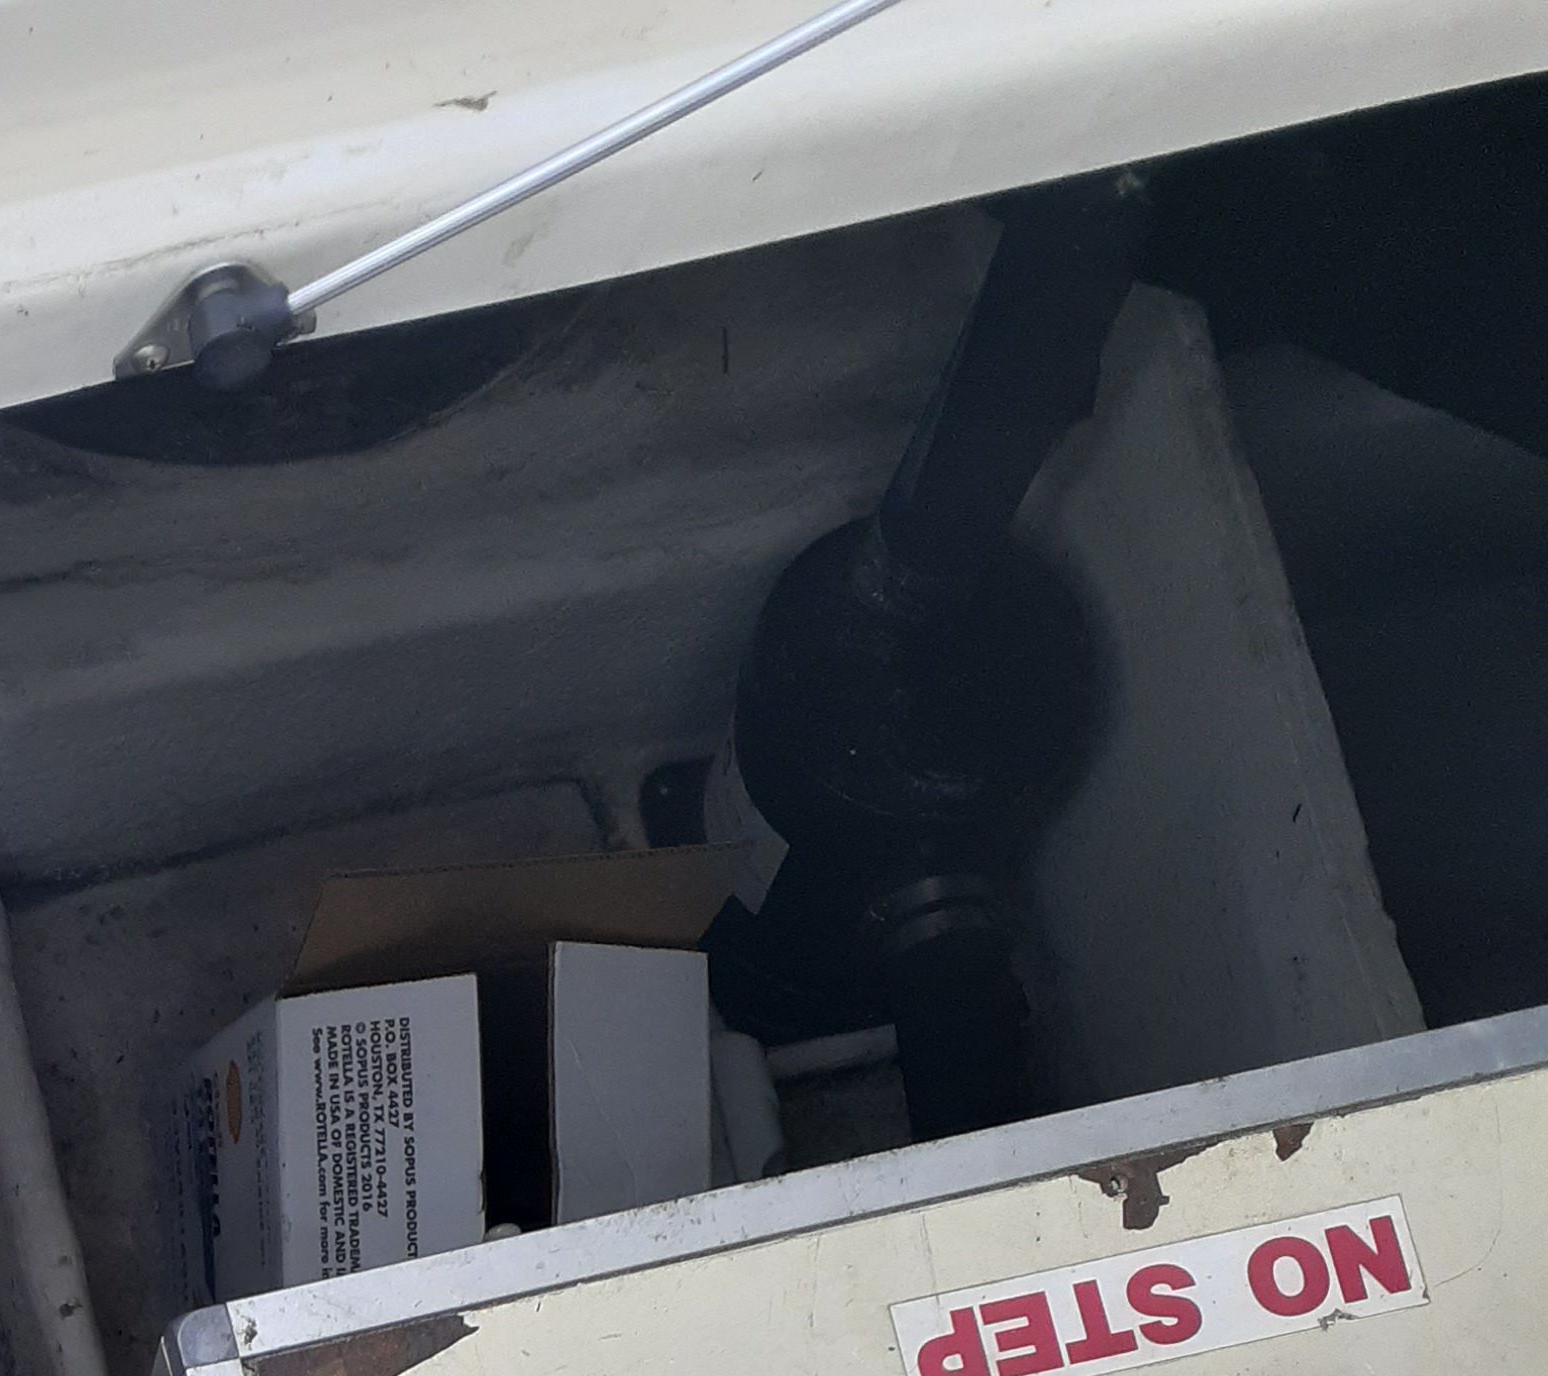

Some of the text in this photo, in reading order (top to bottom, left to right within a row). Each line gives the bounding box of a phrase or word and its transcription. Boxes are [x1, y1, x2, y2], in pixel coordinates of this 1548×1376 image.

[312, 1027, 323, 1054] See
[326, 1025, 339, 1070] MADE
[341, 1024, 354, 1087] ROTELLA
[356, 1038, 369, 1088] SOPUS
[328, 1073, 340, 1090] IN
[384, 1018, 400, 1128] P.O. BOX 4427
[329, 1094, 341, 1125] USA
[344, 1090, 355, 1103] IS
[344, 1107, 355, 1120] A
[370, 1020, 388, 1218] HOUSTON, TX 77210-4427
[314, 1058, 328, 1197] www.ROTELLA.com
[331, 1128, 342, 1149] OF
[358, 1092, 372, 1170] PRODUCTS
[399, 1016, 418, 1258] DISTRIBUTED BY SOPUS PRODUCT
[345, 1123, 358, 1207] REGISTERED
[319, 1200, 331, 1222] for
[332, 1153, 345, 1227] DOMESTIC
[361, 1174, 373, 1212] 2016
[320, 1226, 329, 1264] more
[334, 1230, 346, 1263] AND
[1247, 1215, 1412, 1317] NO
